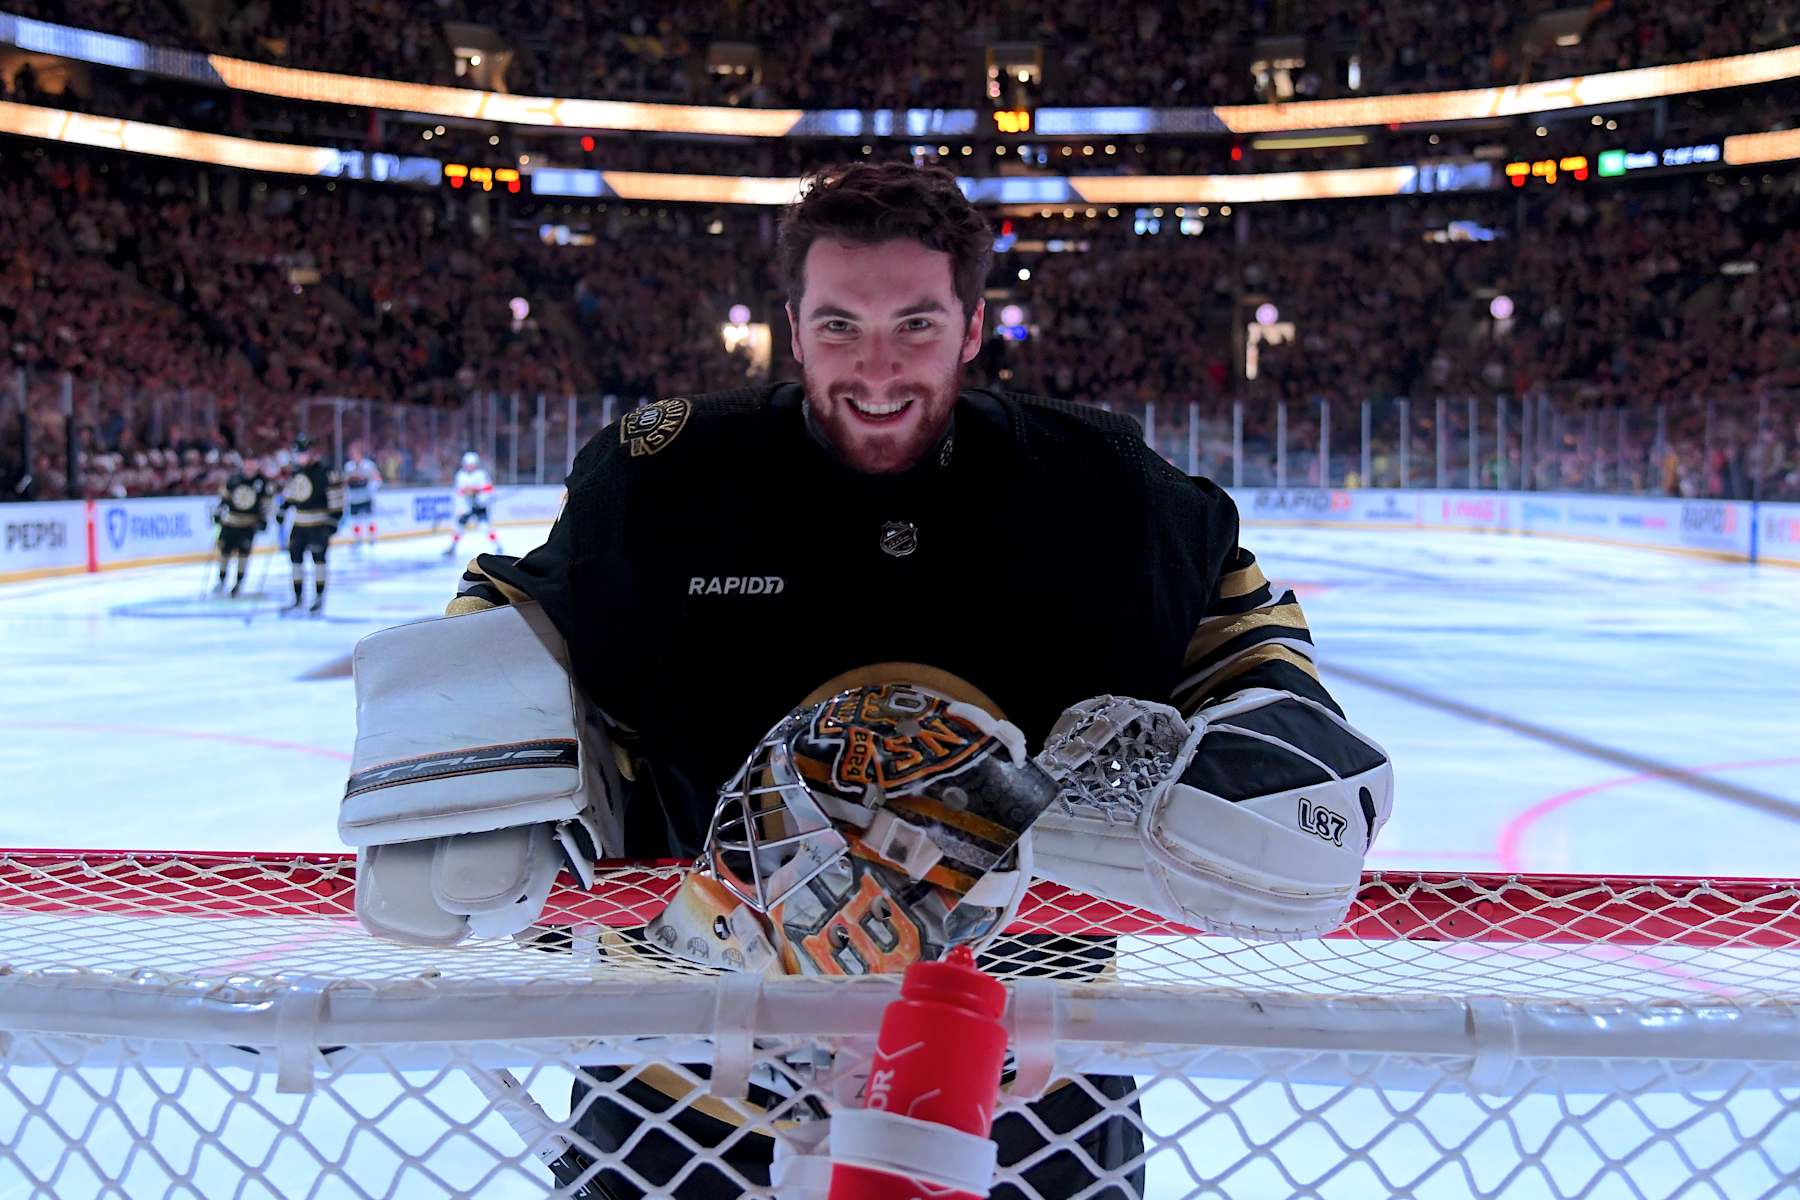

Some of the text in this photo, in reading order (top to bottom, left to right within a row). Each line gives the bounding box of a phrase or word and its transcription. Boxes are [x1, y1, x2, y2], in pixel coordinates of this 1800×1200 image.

[6, 517, 66, 551] PEPSI
[688, 576, 785, 595] RAPID7
[848, 731, 867, 776] 2024
[1298, 797, 1347, 847] L87
